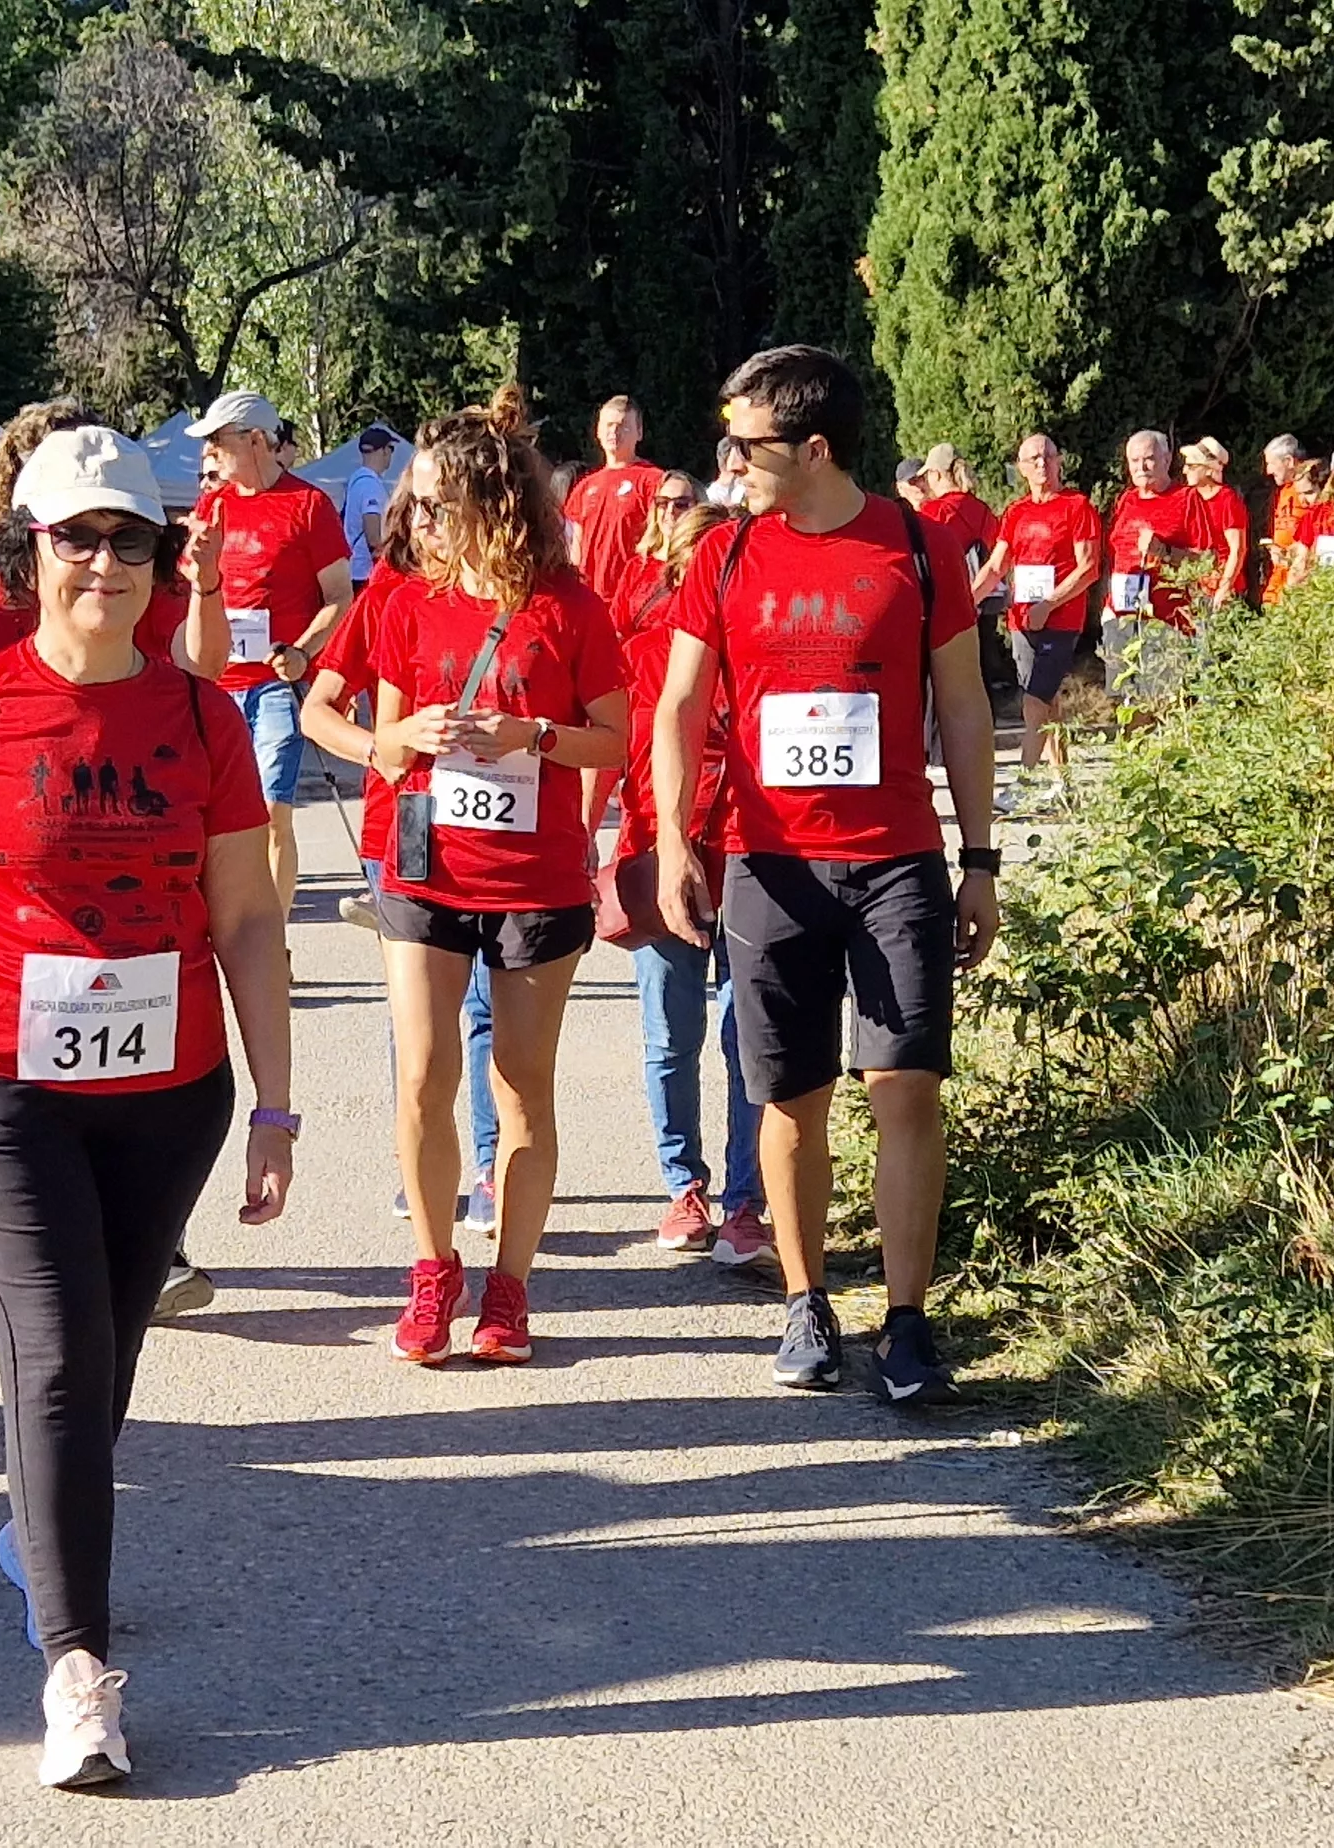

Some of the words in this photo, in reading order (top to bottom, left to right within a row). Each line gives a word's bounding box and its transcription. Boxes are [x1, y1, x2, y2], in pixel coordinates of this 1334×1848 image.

[785, 745, 854, 778] 385
[450, 787, 517, 824] 382
[51, 1021, 147, 1071] 314
